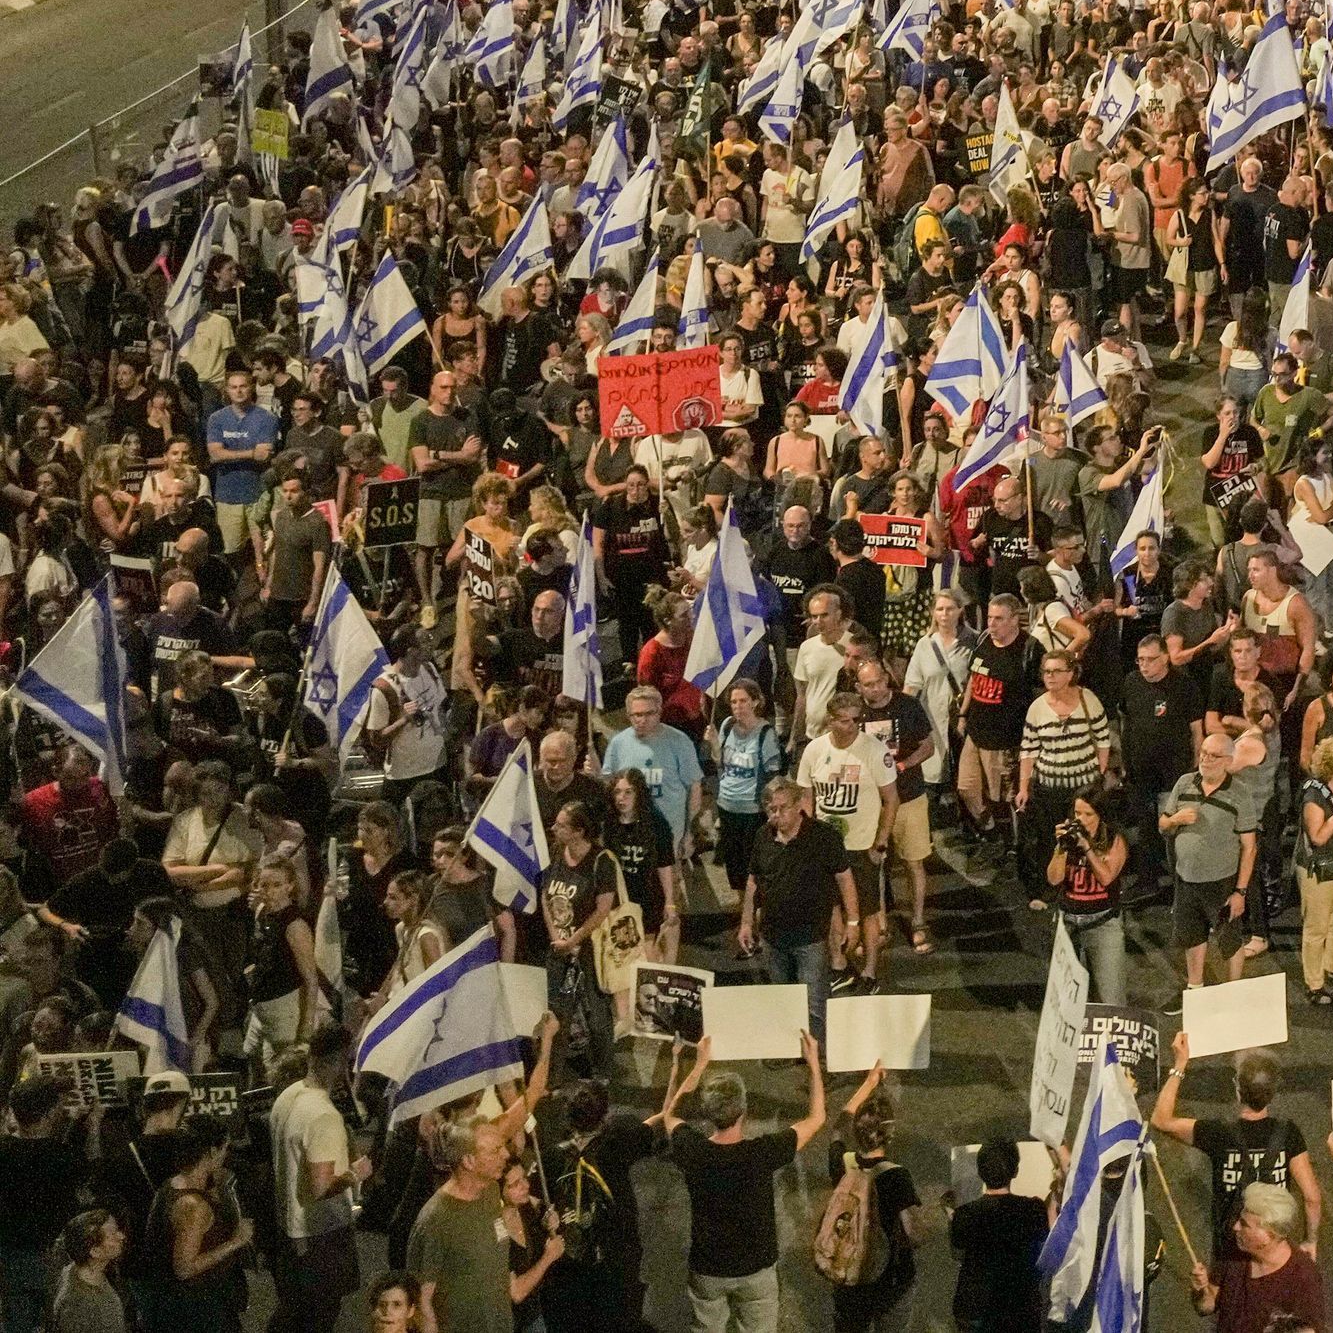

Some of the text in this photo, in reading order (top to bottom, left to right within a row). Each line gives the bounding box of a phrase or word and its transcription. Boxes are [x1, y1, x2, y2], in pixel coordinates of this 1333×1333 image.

[966, 133, 994, 149] HOSTAG
[968, 147, 988, 160] DEAL
[970, 159, 989, 173] NOW
[470, 532, 483, 548] רק
[467, 570, 494, 601] 120
[1093, 1015, 1141, 1036] שלום
